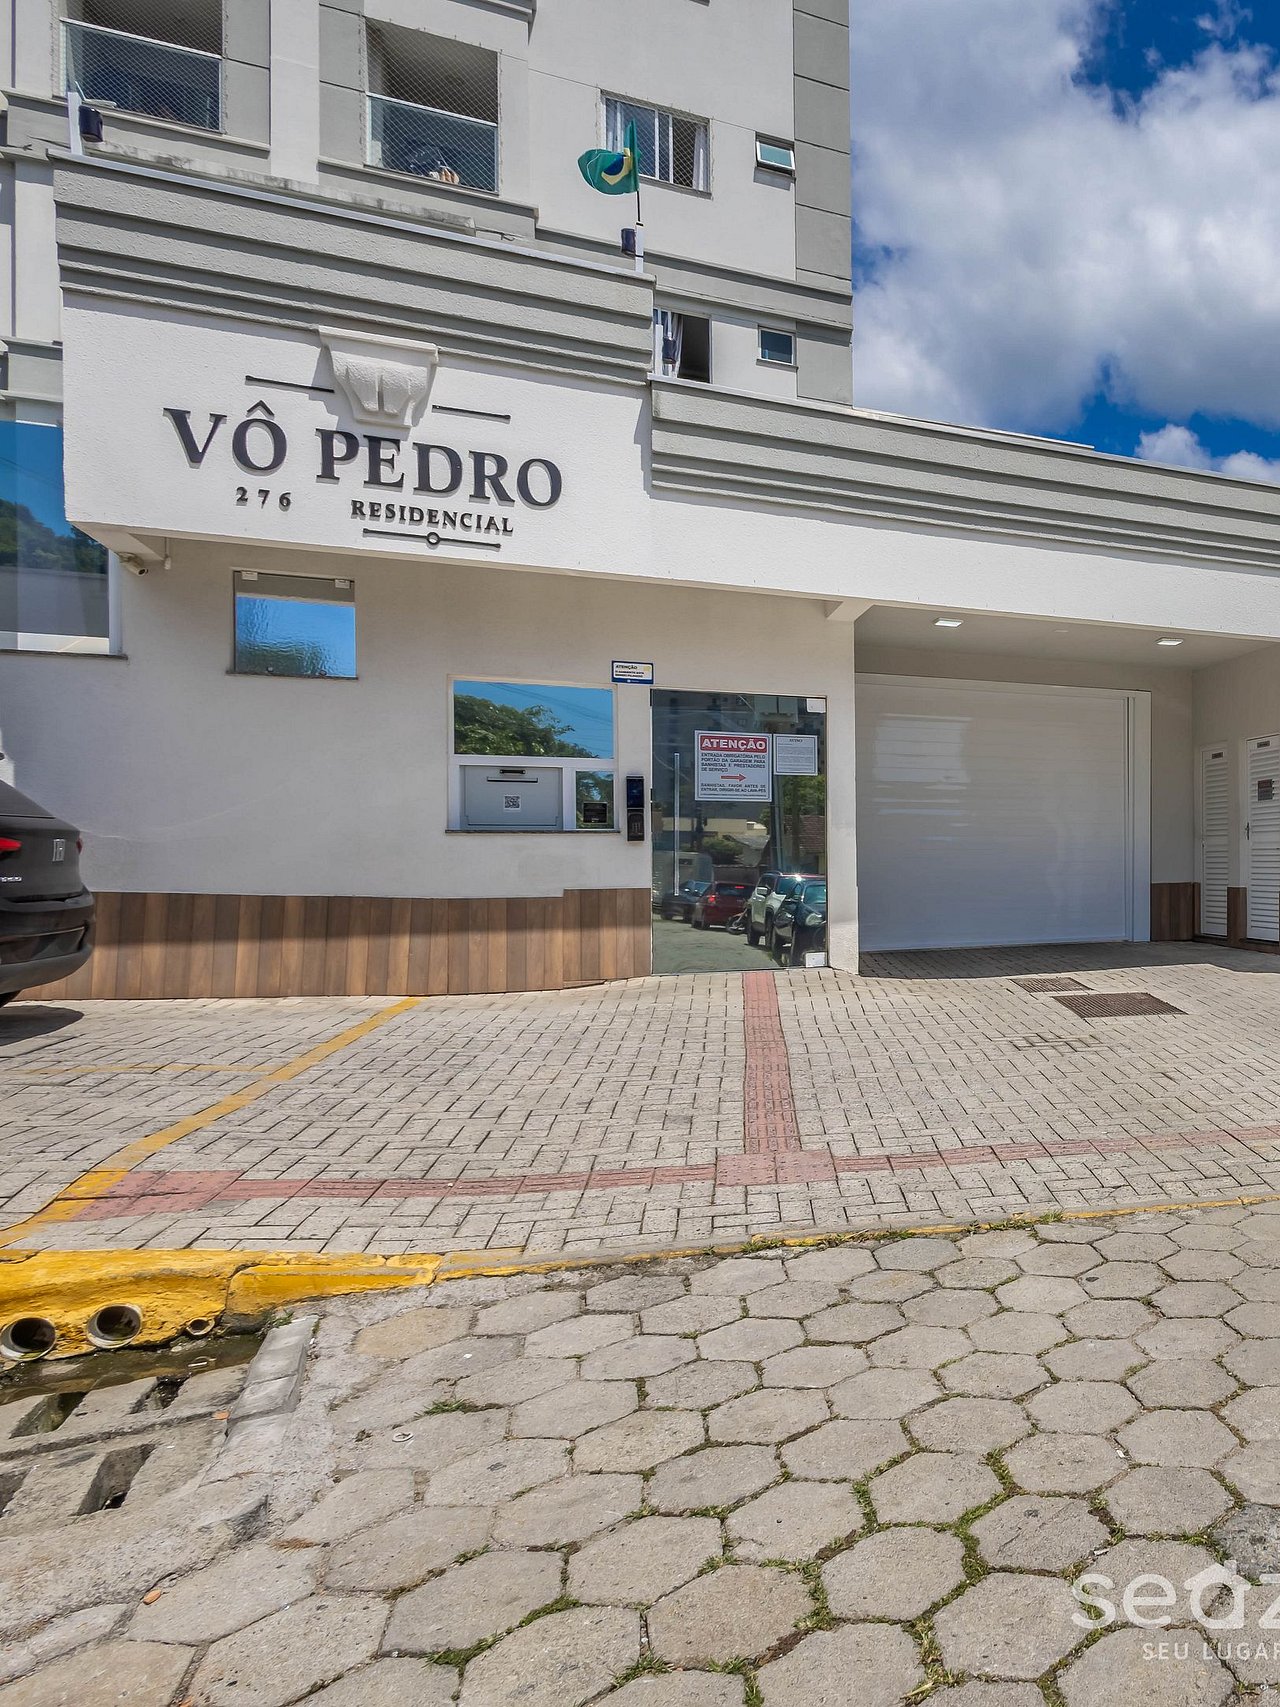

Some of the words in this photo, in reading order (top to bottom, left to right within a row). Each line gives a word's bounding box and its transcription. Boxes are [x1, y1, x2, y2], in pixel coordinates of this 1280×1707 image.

[163, 400, 287, 476] VÔ
[315, 428, 562, 509] PEDRO
[235, 486, 291, 512] 276
[350, 500, 514, 535] RESIDENCIAL
[702, 738, 766, 751] ATENÇÃO
